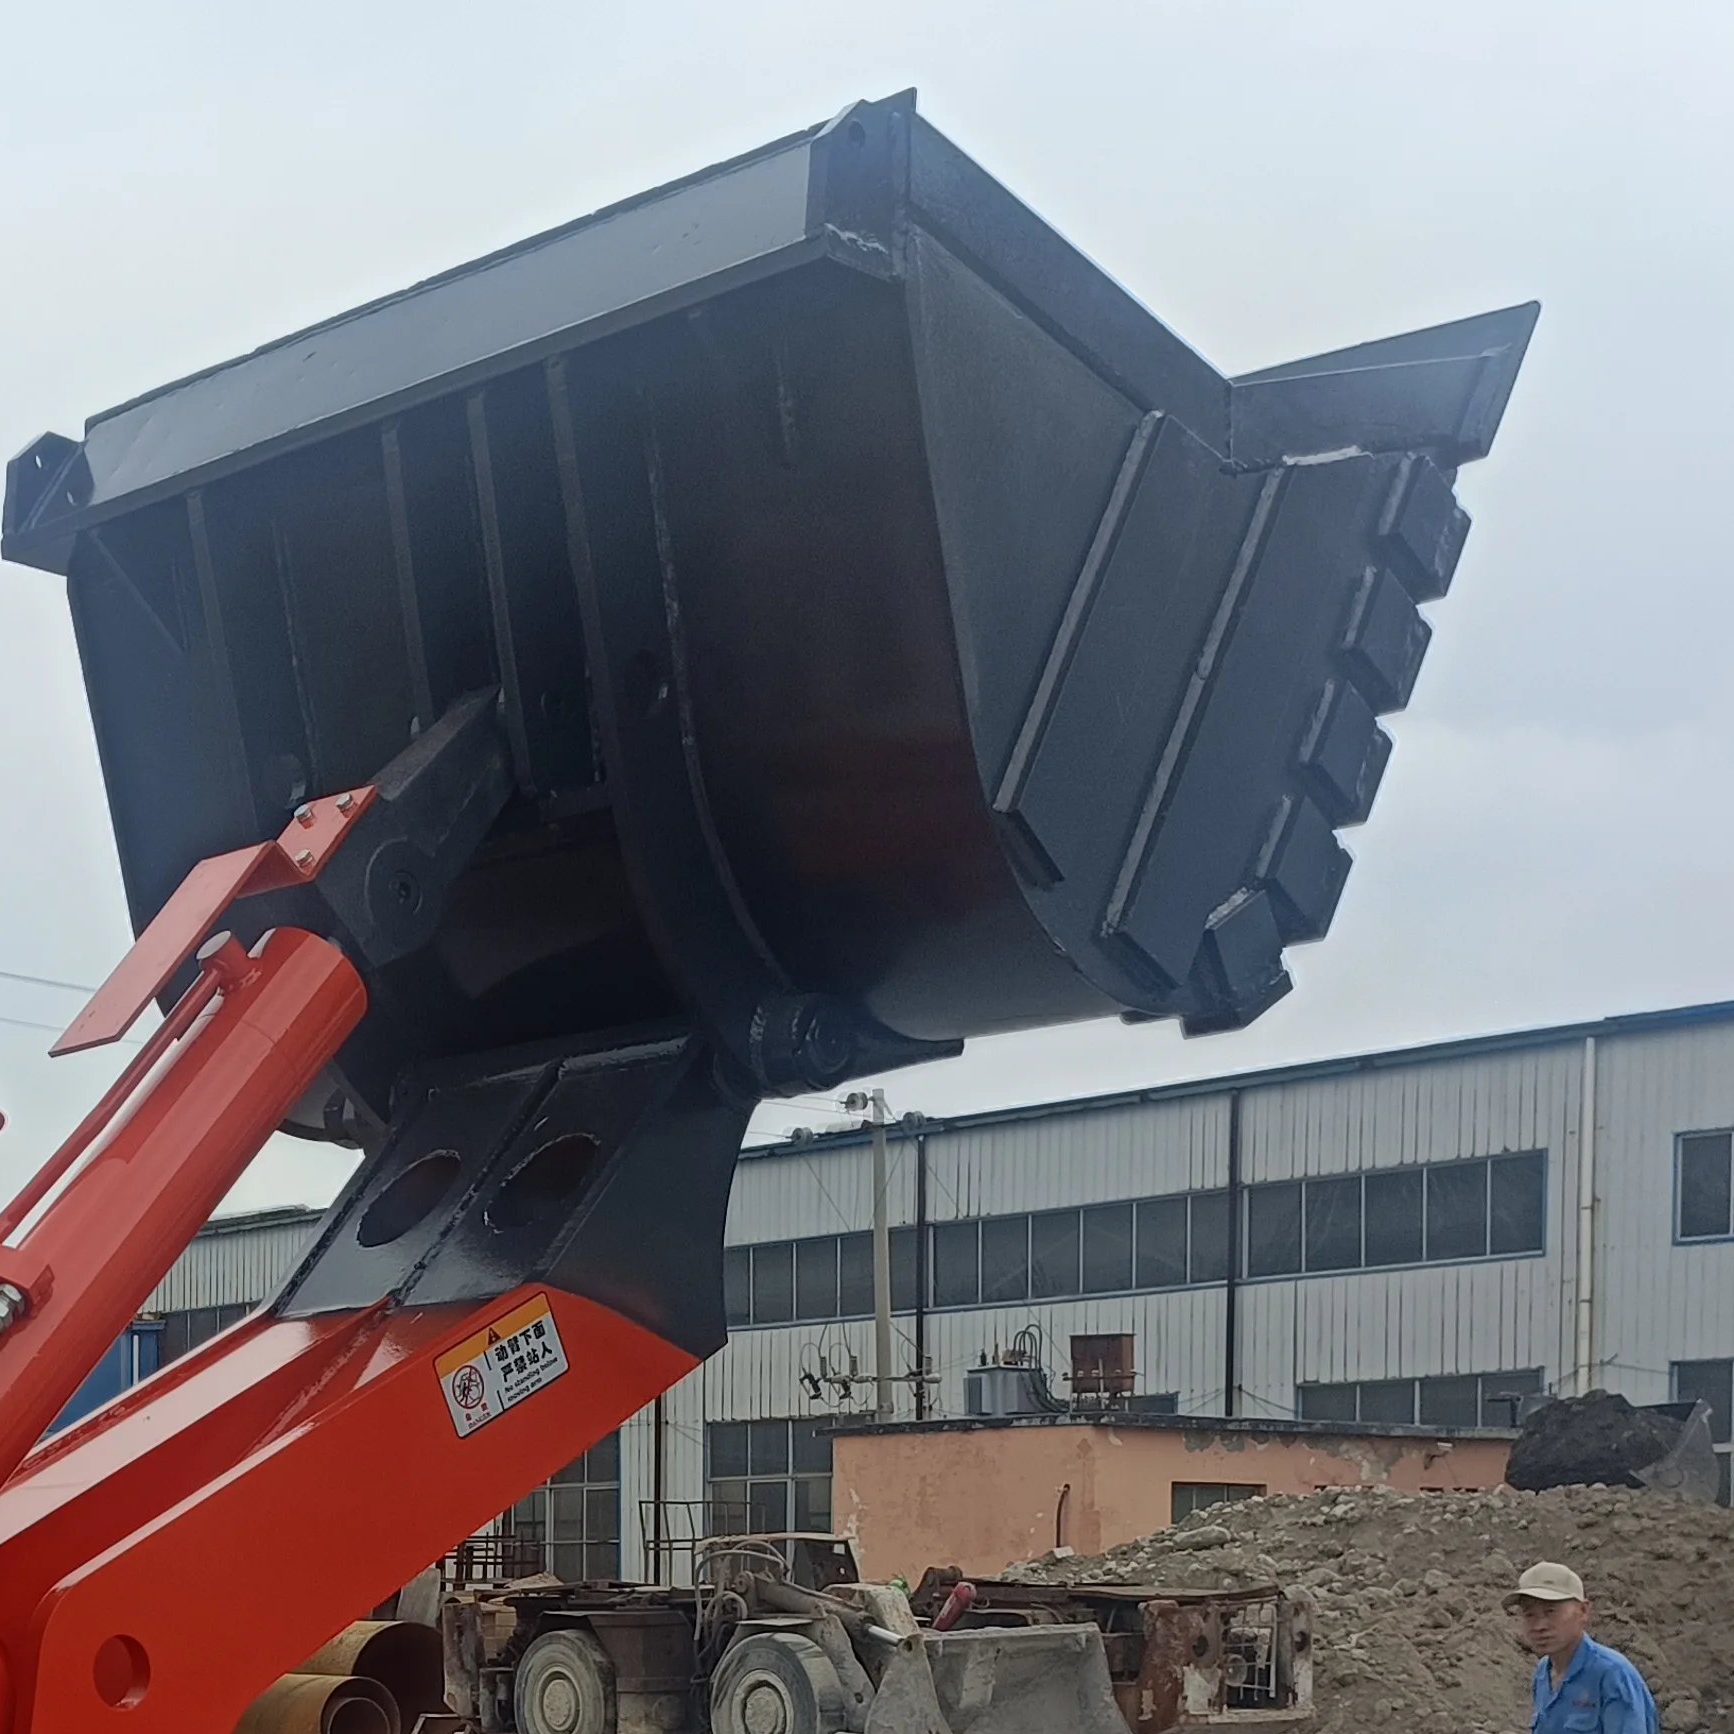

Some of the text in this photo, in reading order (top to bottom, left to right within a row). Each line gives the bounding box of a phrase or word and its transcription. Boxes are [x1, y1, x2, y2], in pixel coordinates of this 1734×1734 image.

[494, 1320, 546, 1362] 动臂下面
[500, 1341, 553, 1383] 严禁站人
